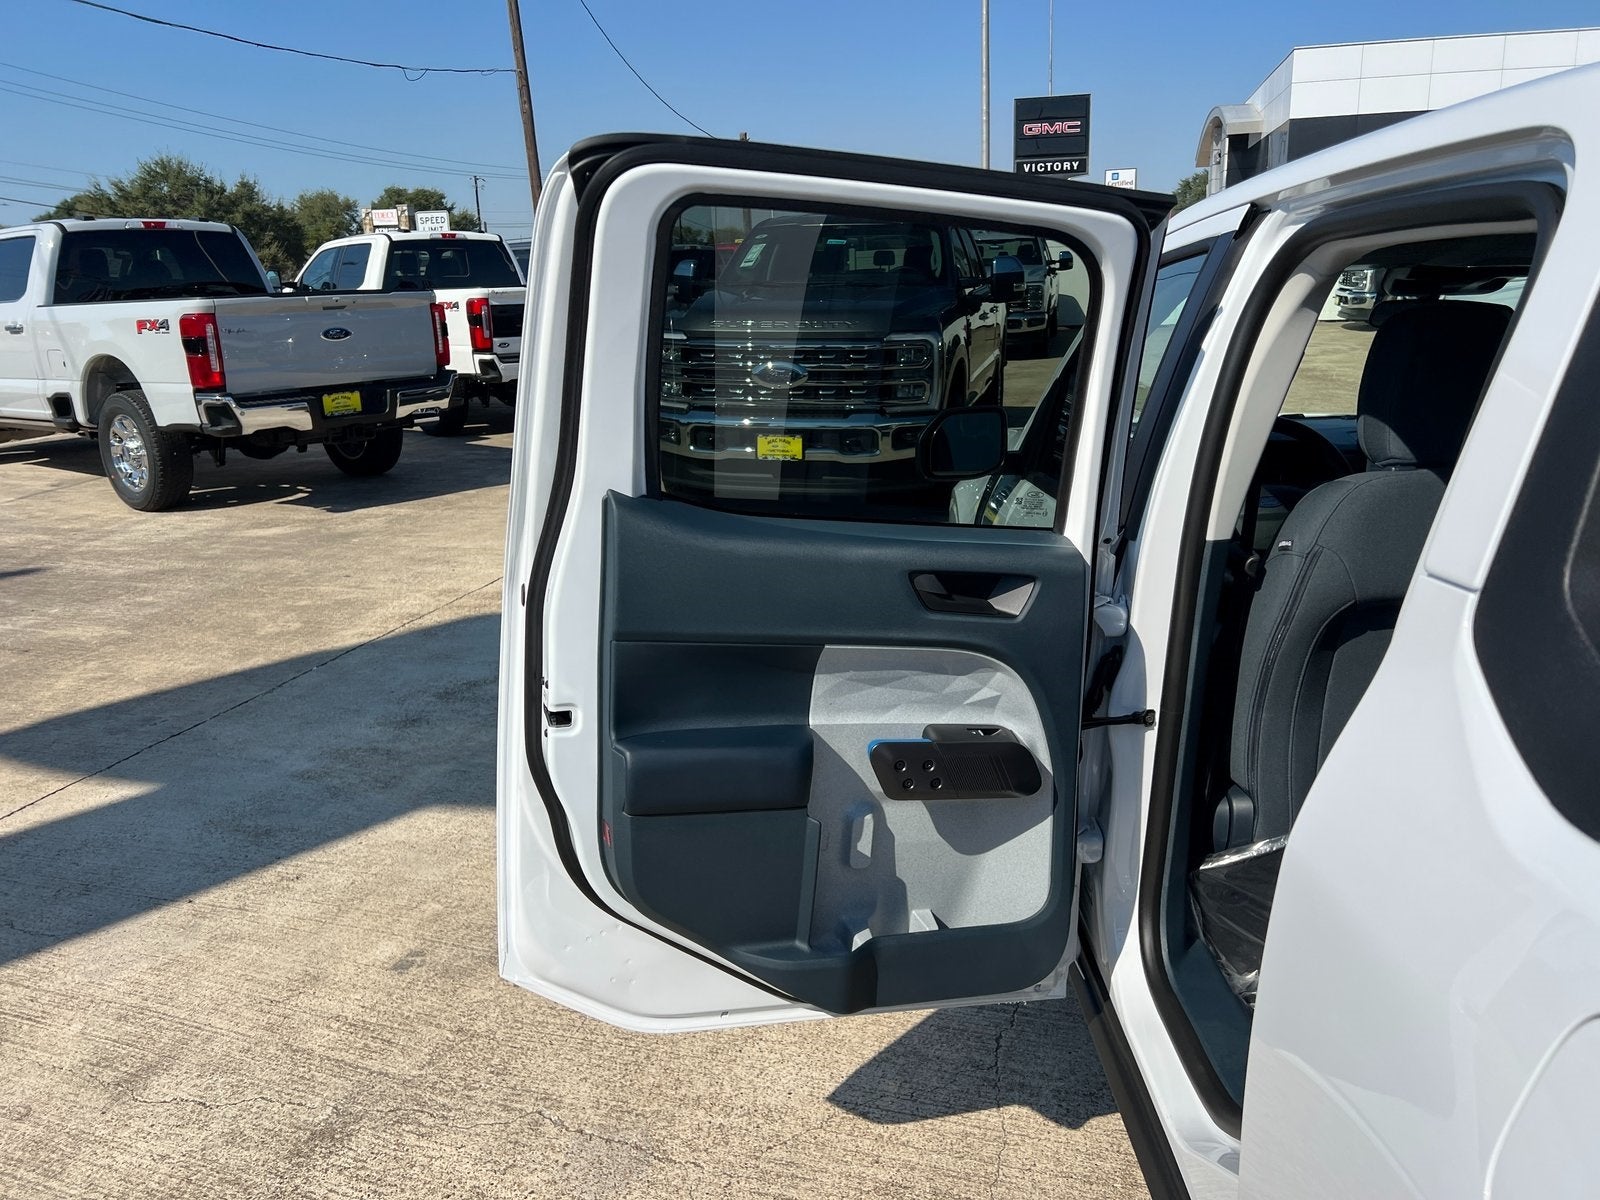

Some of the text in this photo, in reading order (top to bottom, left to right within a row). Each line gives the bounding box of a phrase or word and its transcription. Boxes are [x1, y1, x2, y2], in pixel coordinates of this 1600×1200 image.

[1023, 121, 1081, 136] GMC
[1023, 161, 1080, 173] VICTORY
[419, 216, 446, 225] SPEED
[136, 319, 170, 335] FX4
